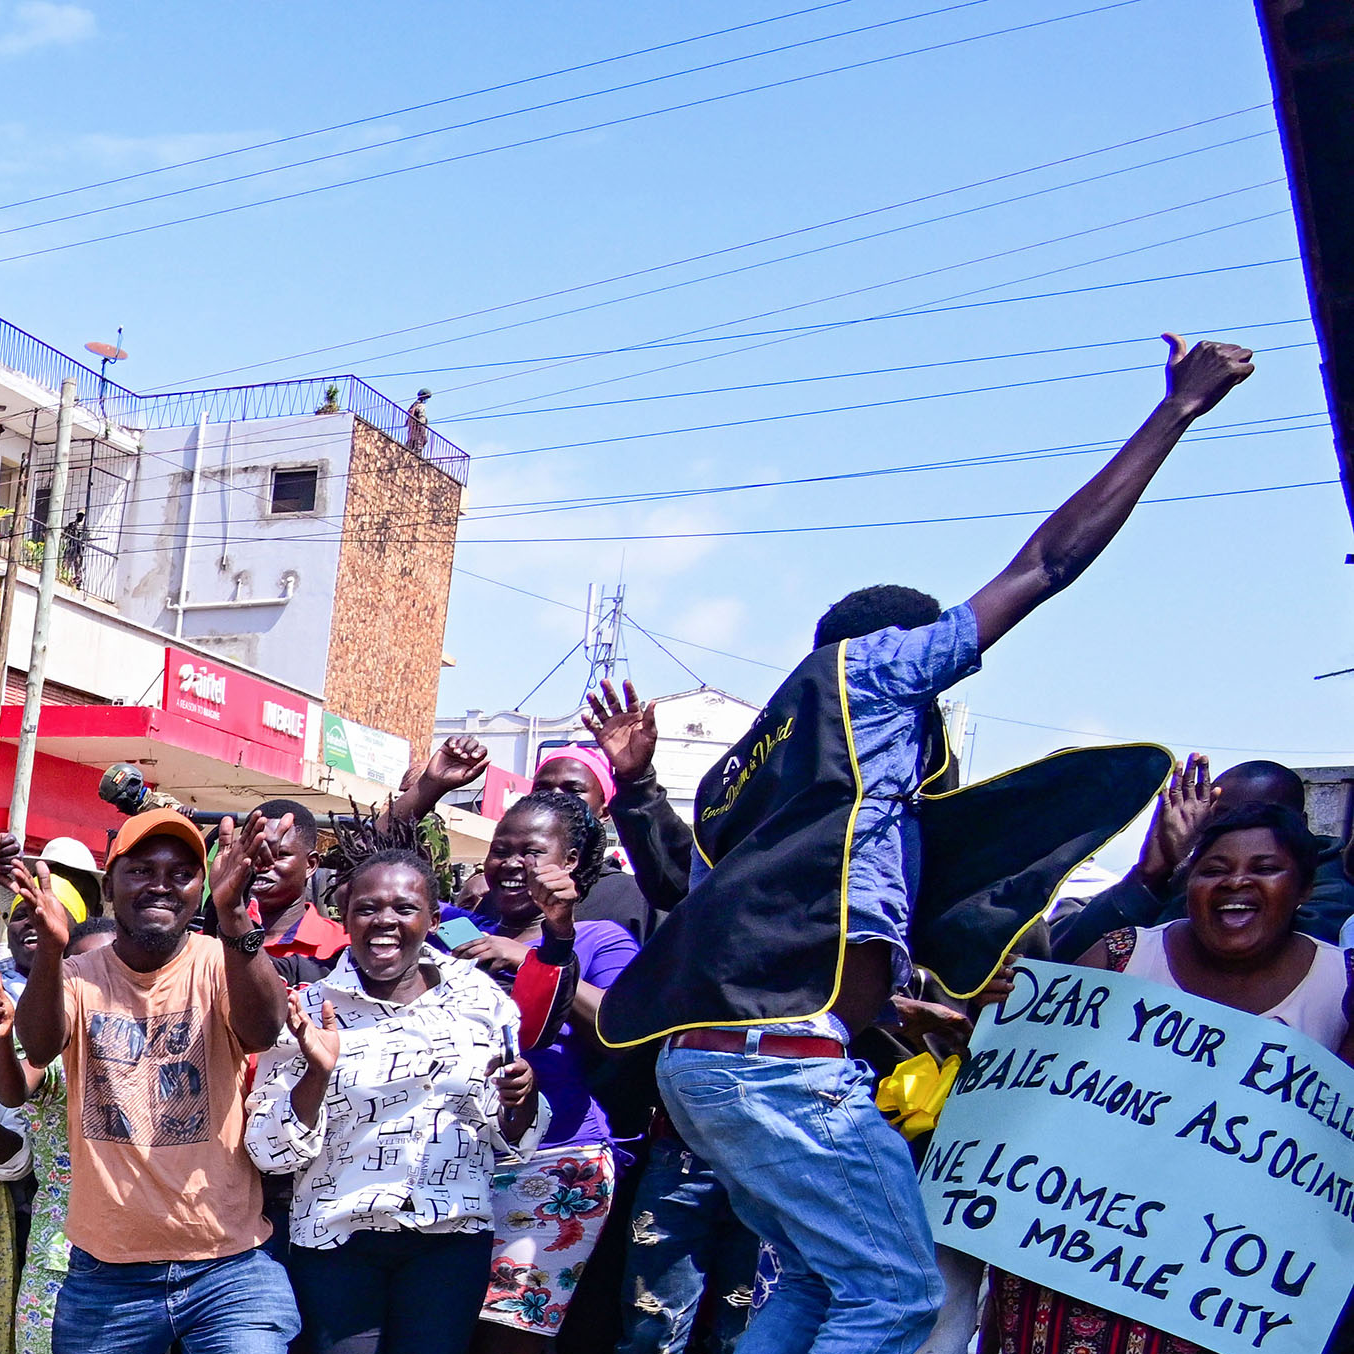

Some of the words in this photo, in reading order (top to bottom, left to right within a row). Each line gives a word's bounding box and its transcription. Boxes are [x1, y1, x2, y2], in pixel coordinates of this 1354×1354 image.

[193, 666, 226, 705] airtel
[994, 966, 1110, 1029] DEAR
[1128, 997, 1225, 1068] YOUR
[1239, 1041, 1354, 1142] EXCELL
[947, 1048, 1059, 1098] MBALE
[1049, 1060, 1172, 1125] SALONS
[1175, 1100, 1354, 1224] ASSOCIATI
[918, 1139, 1166, 1238] WELCOMES
[1200, 1213, 1317, 1297] YOU
[942, 1189, 998, 1230] TO
[1019, 1217, 1184, 1300] MBALE
[1190, 1287, 1292, 1348] CITY
